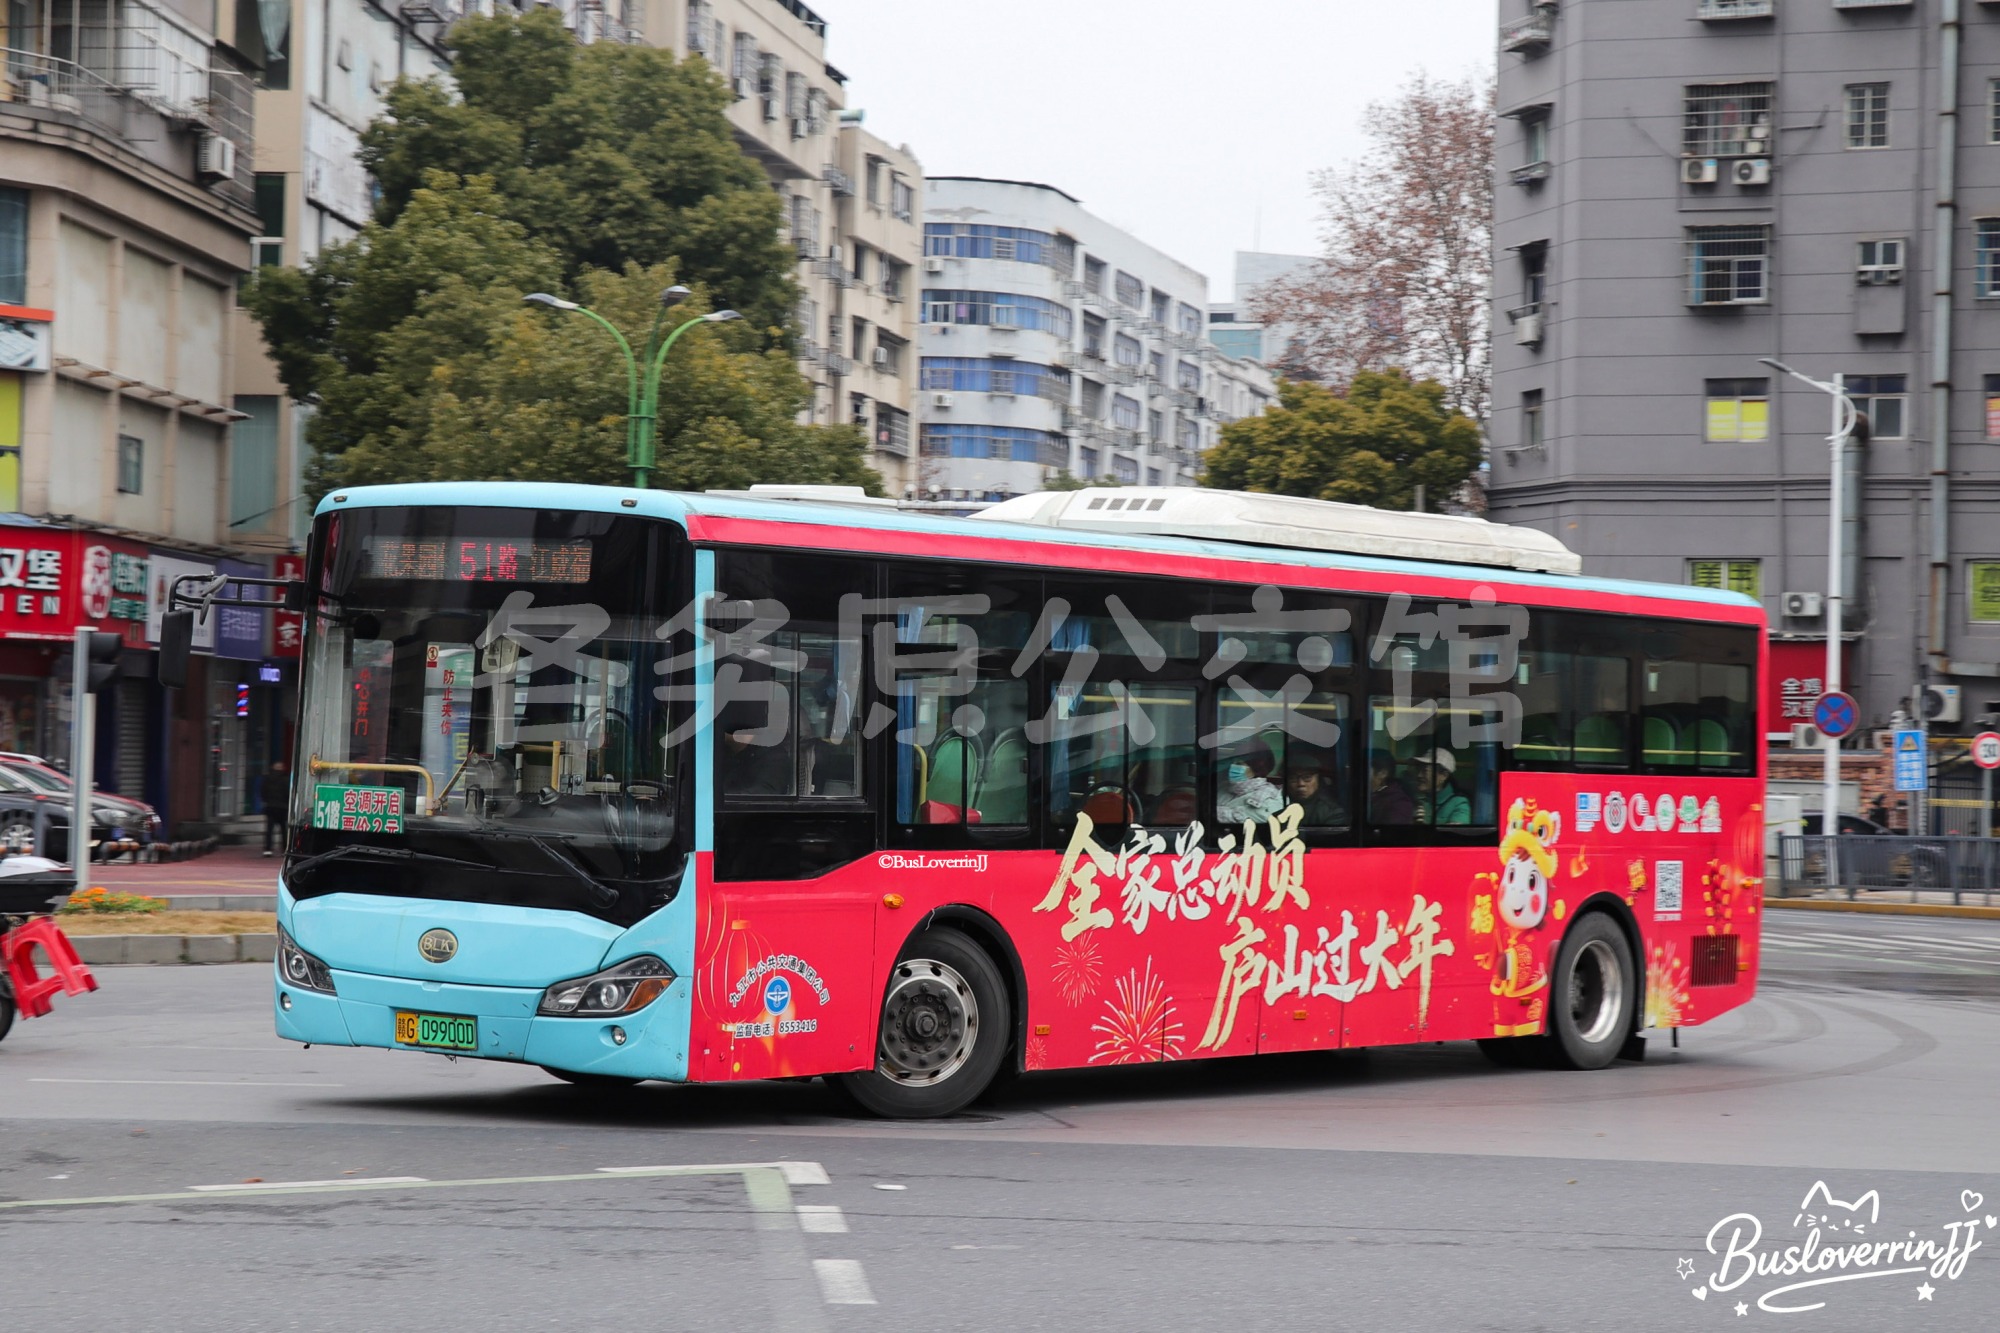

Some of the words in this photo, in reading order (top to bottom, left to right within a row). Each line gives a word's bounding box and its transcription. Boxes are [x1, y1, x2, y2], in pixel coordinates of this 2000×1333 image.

[440, 669, 455, 736] 防止夹伤
[343, 789, 401, 816] 空调开启
[1032, 803, 1311, 942] 全家总动员
[729, 953, 831, 1008] 九江市公共交通集团公司
[1193, 895, 1455, 1053] 庐山过大年
